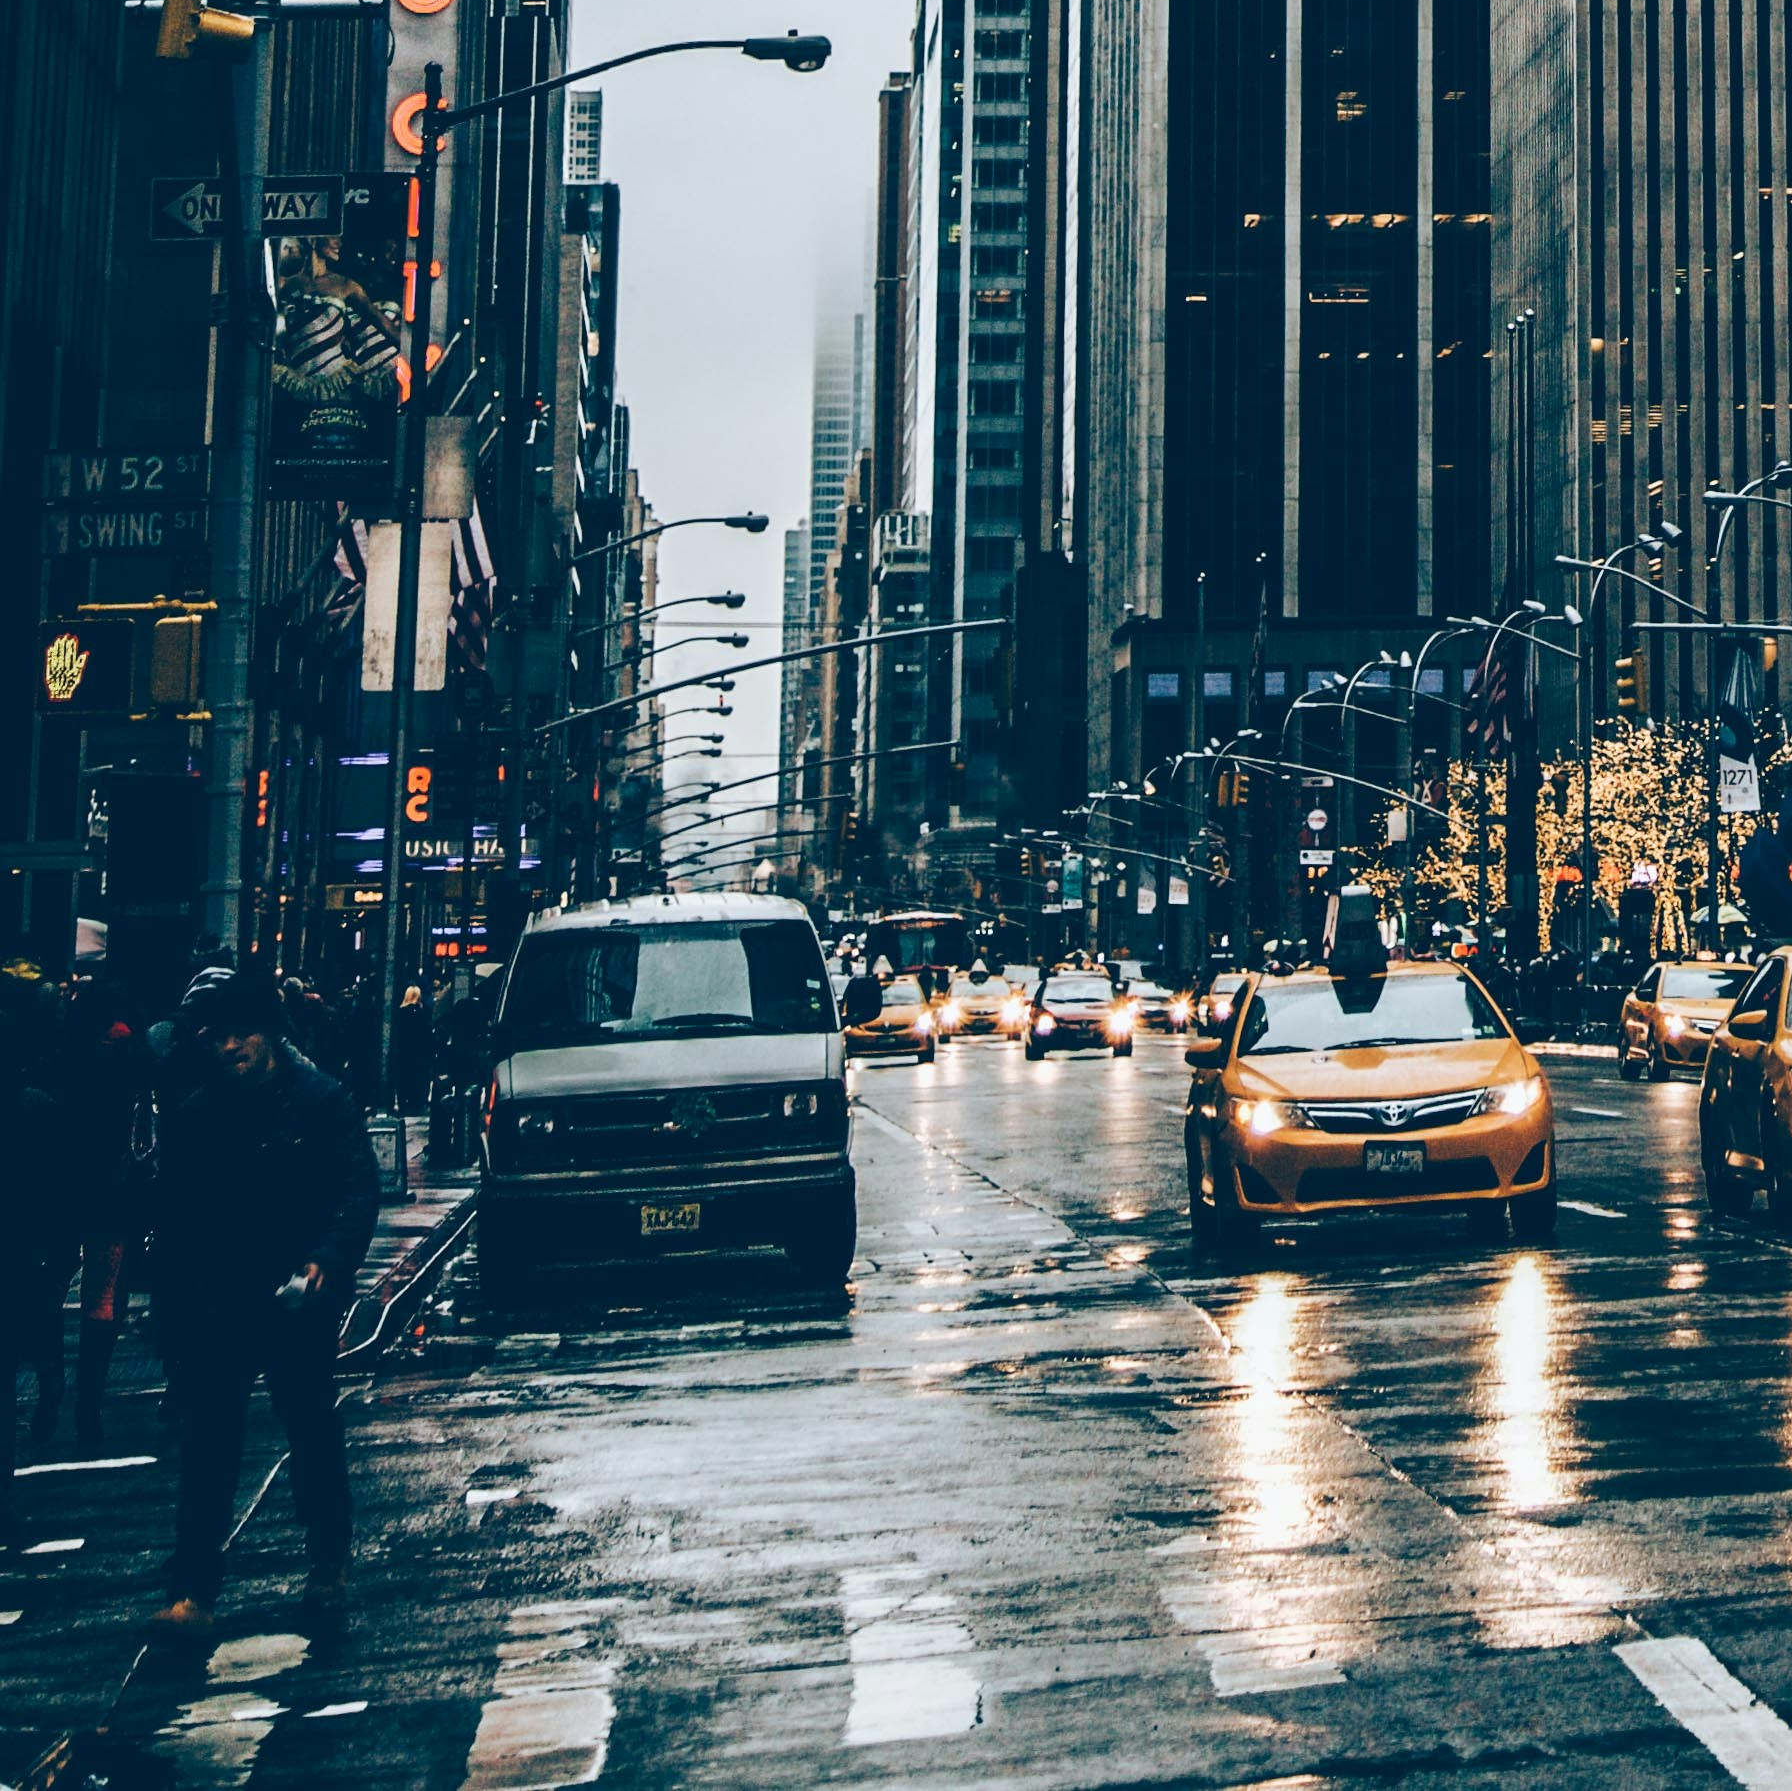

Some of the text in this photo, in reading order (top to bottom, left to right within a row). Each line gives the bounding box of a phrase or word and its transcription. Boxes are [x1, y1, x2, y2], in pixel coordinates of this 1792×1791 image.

[264, 193, 317, 219] WAY
[82, 454, 200, 492] W 52 ST
[78, 510, 199, 548] SWING ST
[1723, 770, 1753, 785] 1271
